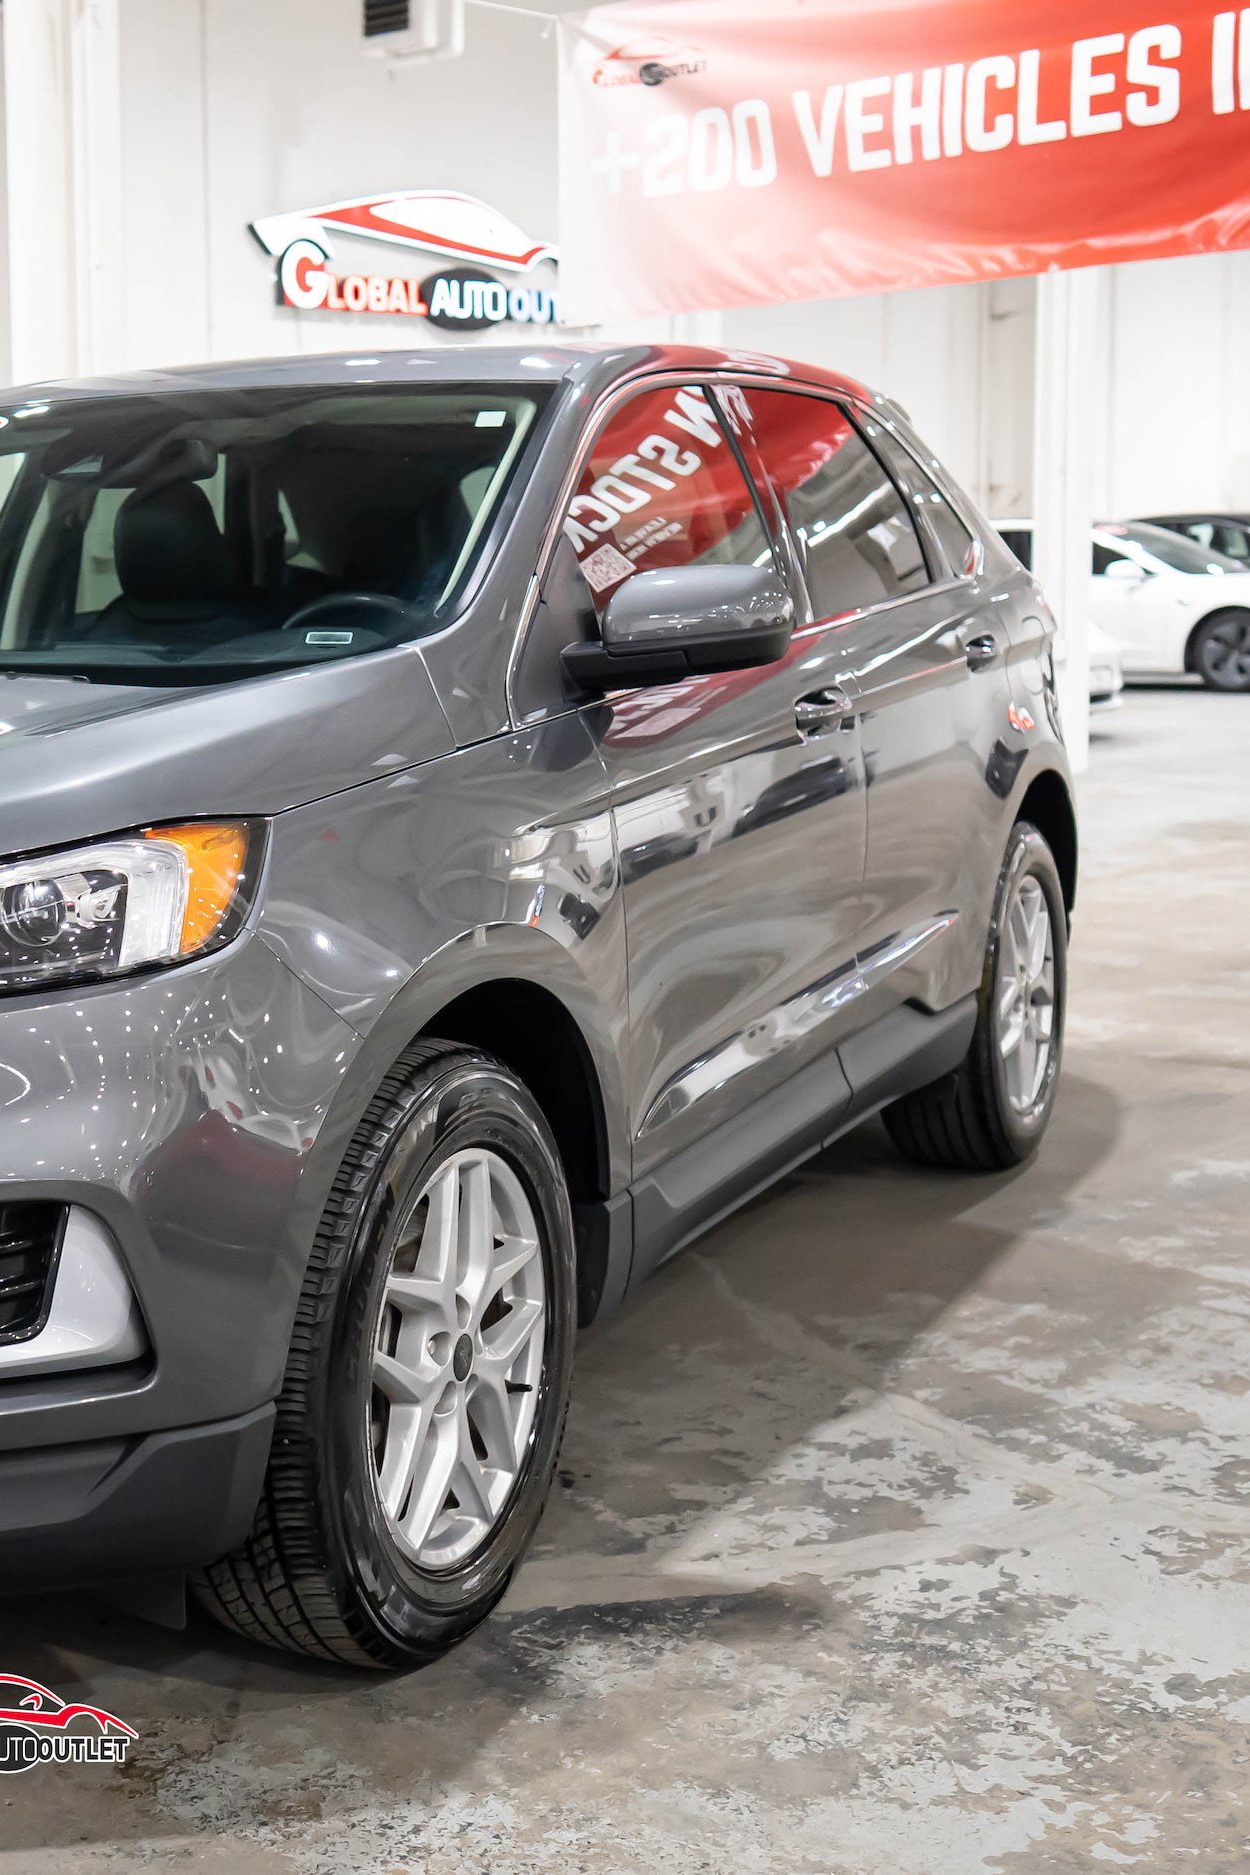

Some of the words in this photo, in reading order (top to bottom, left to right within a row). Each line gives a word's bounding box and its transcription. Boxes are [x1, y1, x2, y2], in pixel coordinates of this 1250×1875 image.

[590, 99, 778, 197] +200
[793, 24, 1182, 177] VEHICLES
[430, 279, 507, 321] AUTO
